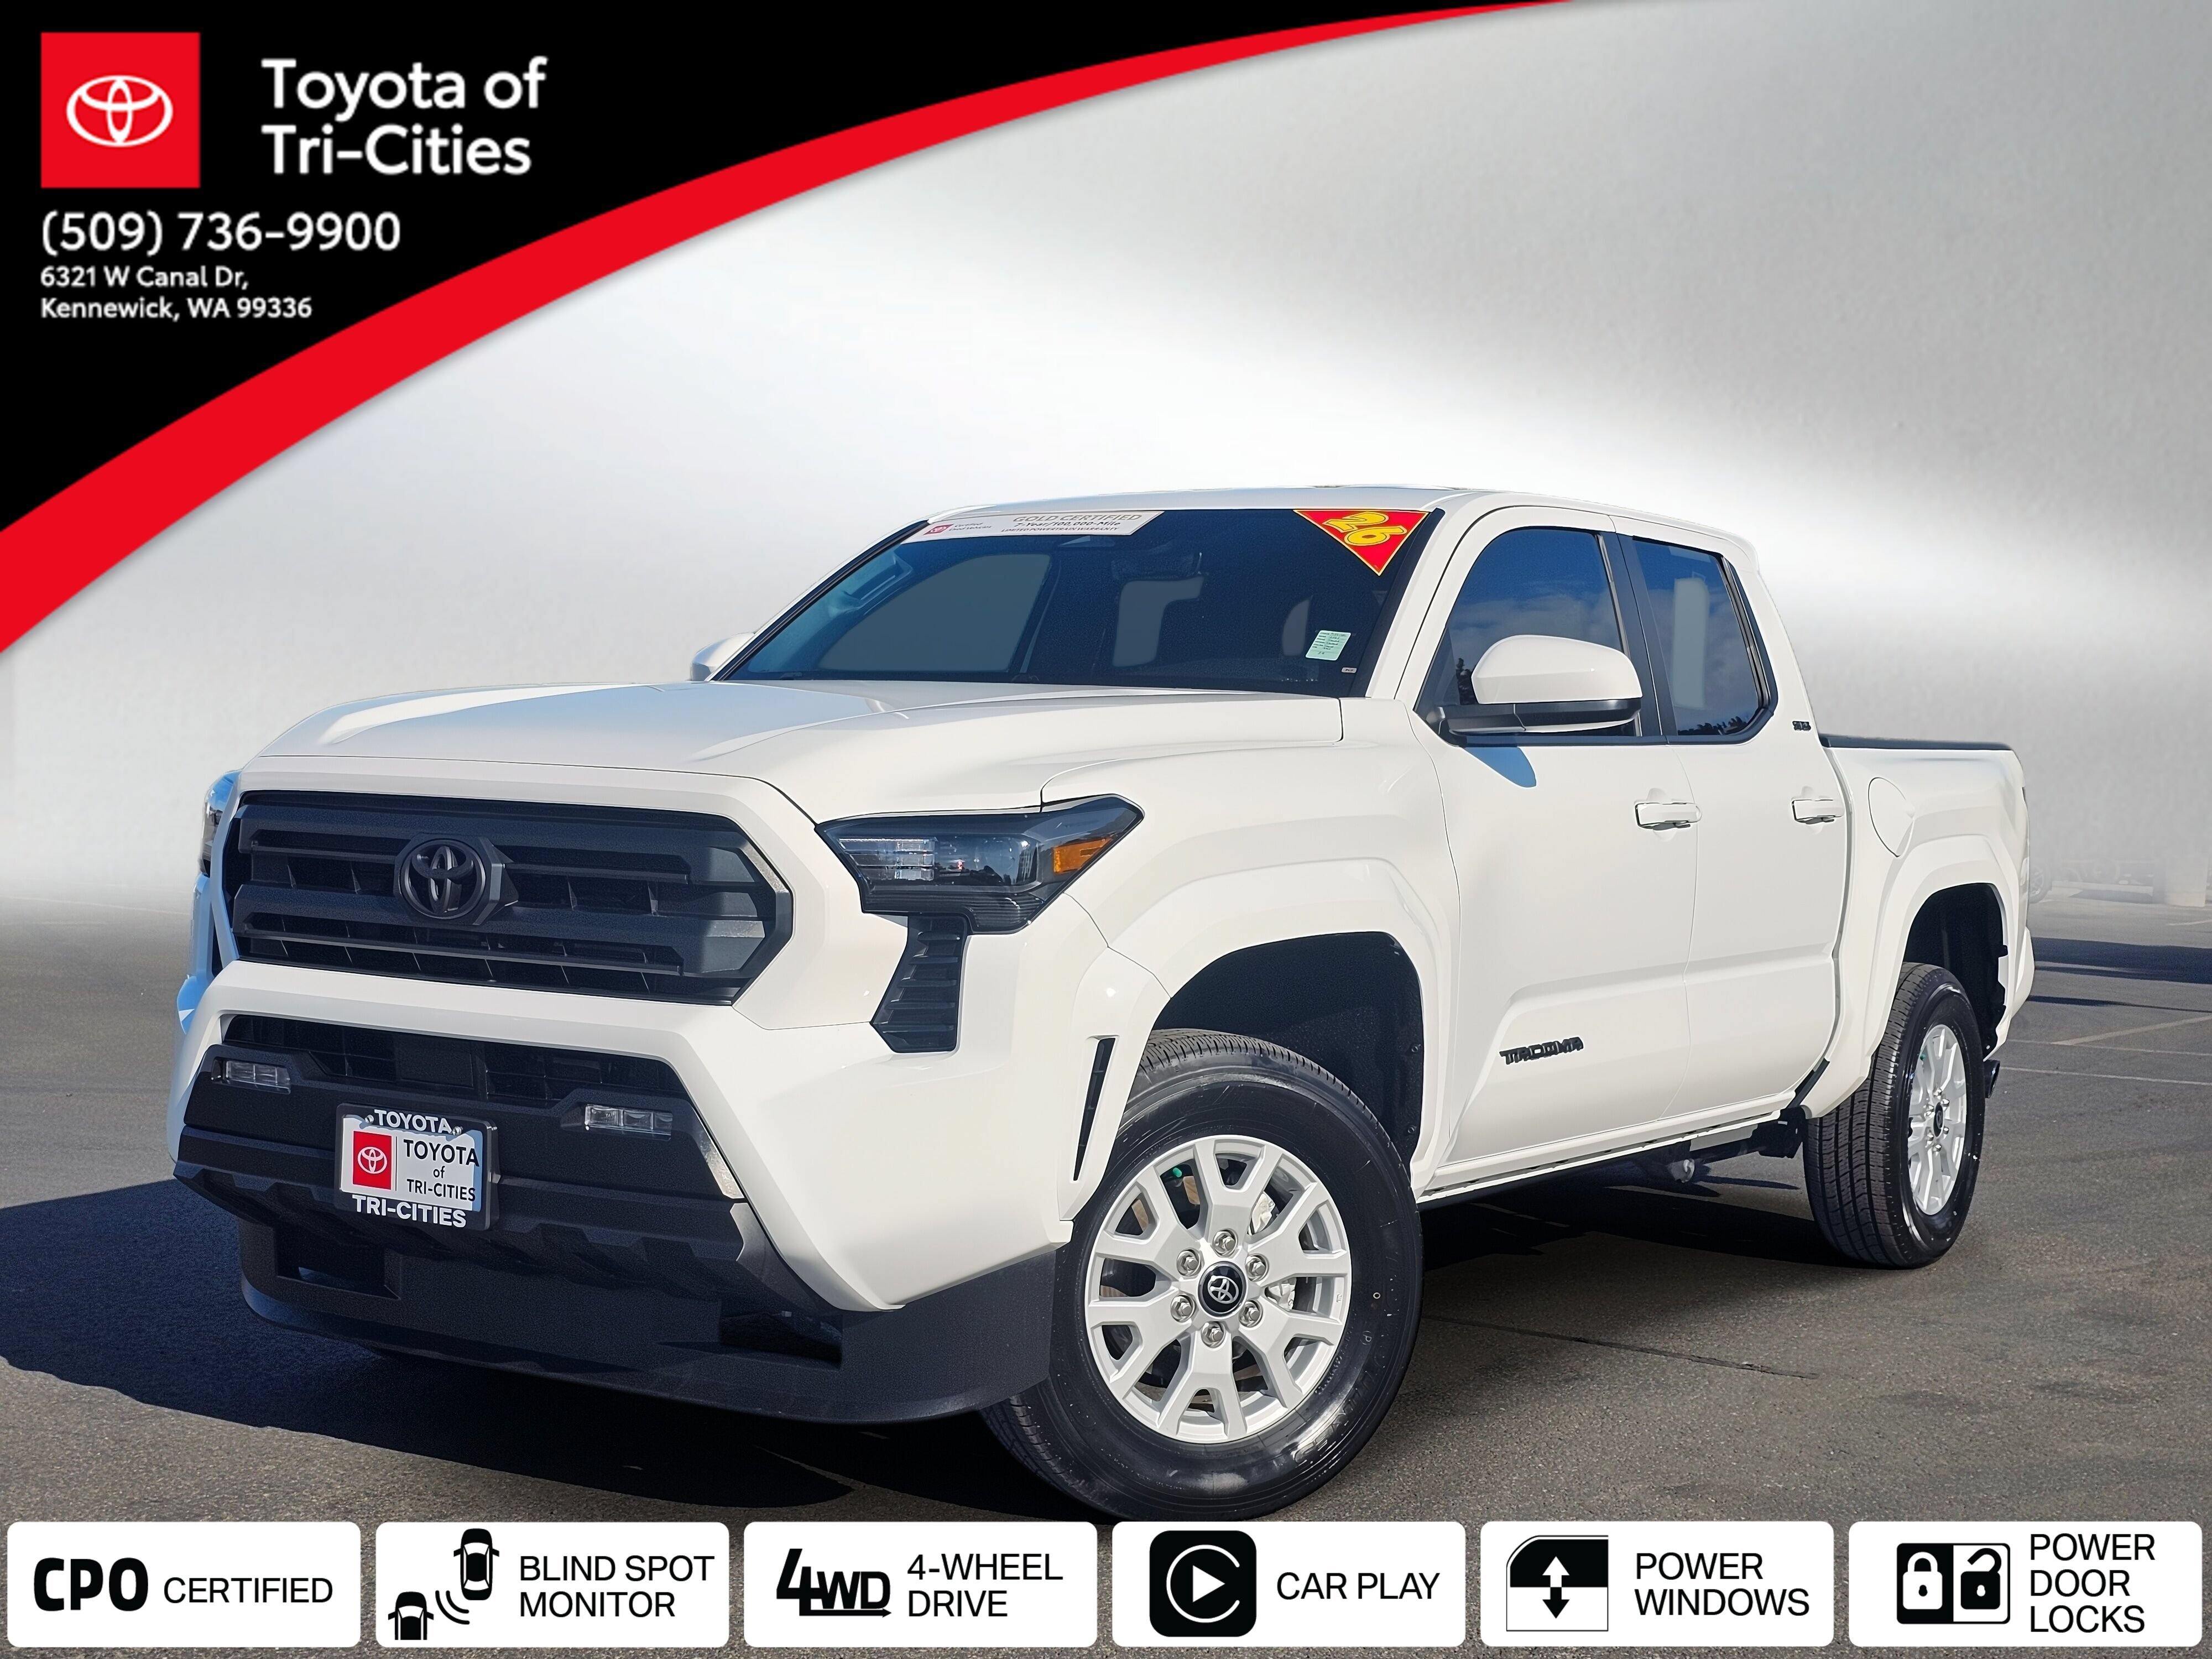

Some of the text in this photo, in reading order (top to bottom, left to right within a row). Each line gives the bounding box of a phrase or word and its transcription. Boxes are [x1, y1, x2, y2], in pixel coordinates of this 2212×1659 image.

[1322, 512, 1407, 546] 26
[1499, 1037, 1584, 1065] TACOMA
[374, 1109, 452, 1134] TOYOTA
[403, 1139, 480, 1167] TOYOTA
[433, 1166, 445, 1178] of
[406, 1179, 476, 1202] TRI-CITIES
[352, 1194, 466, 1228] TRI-CITIES
